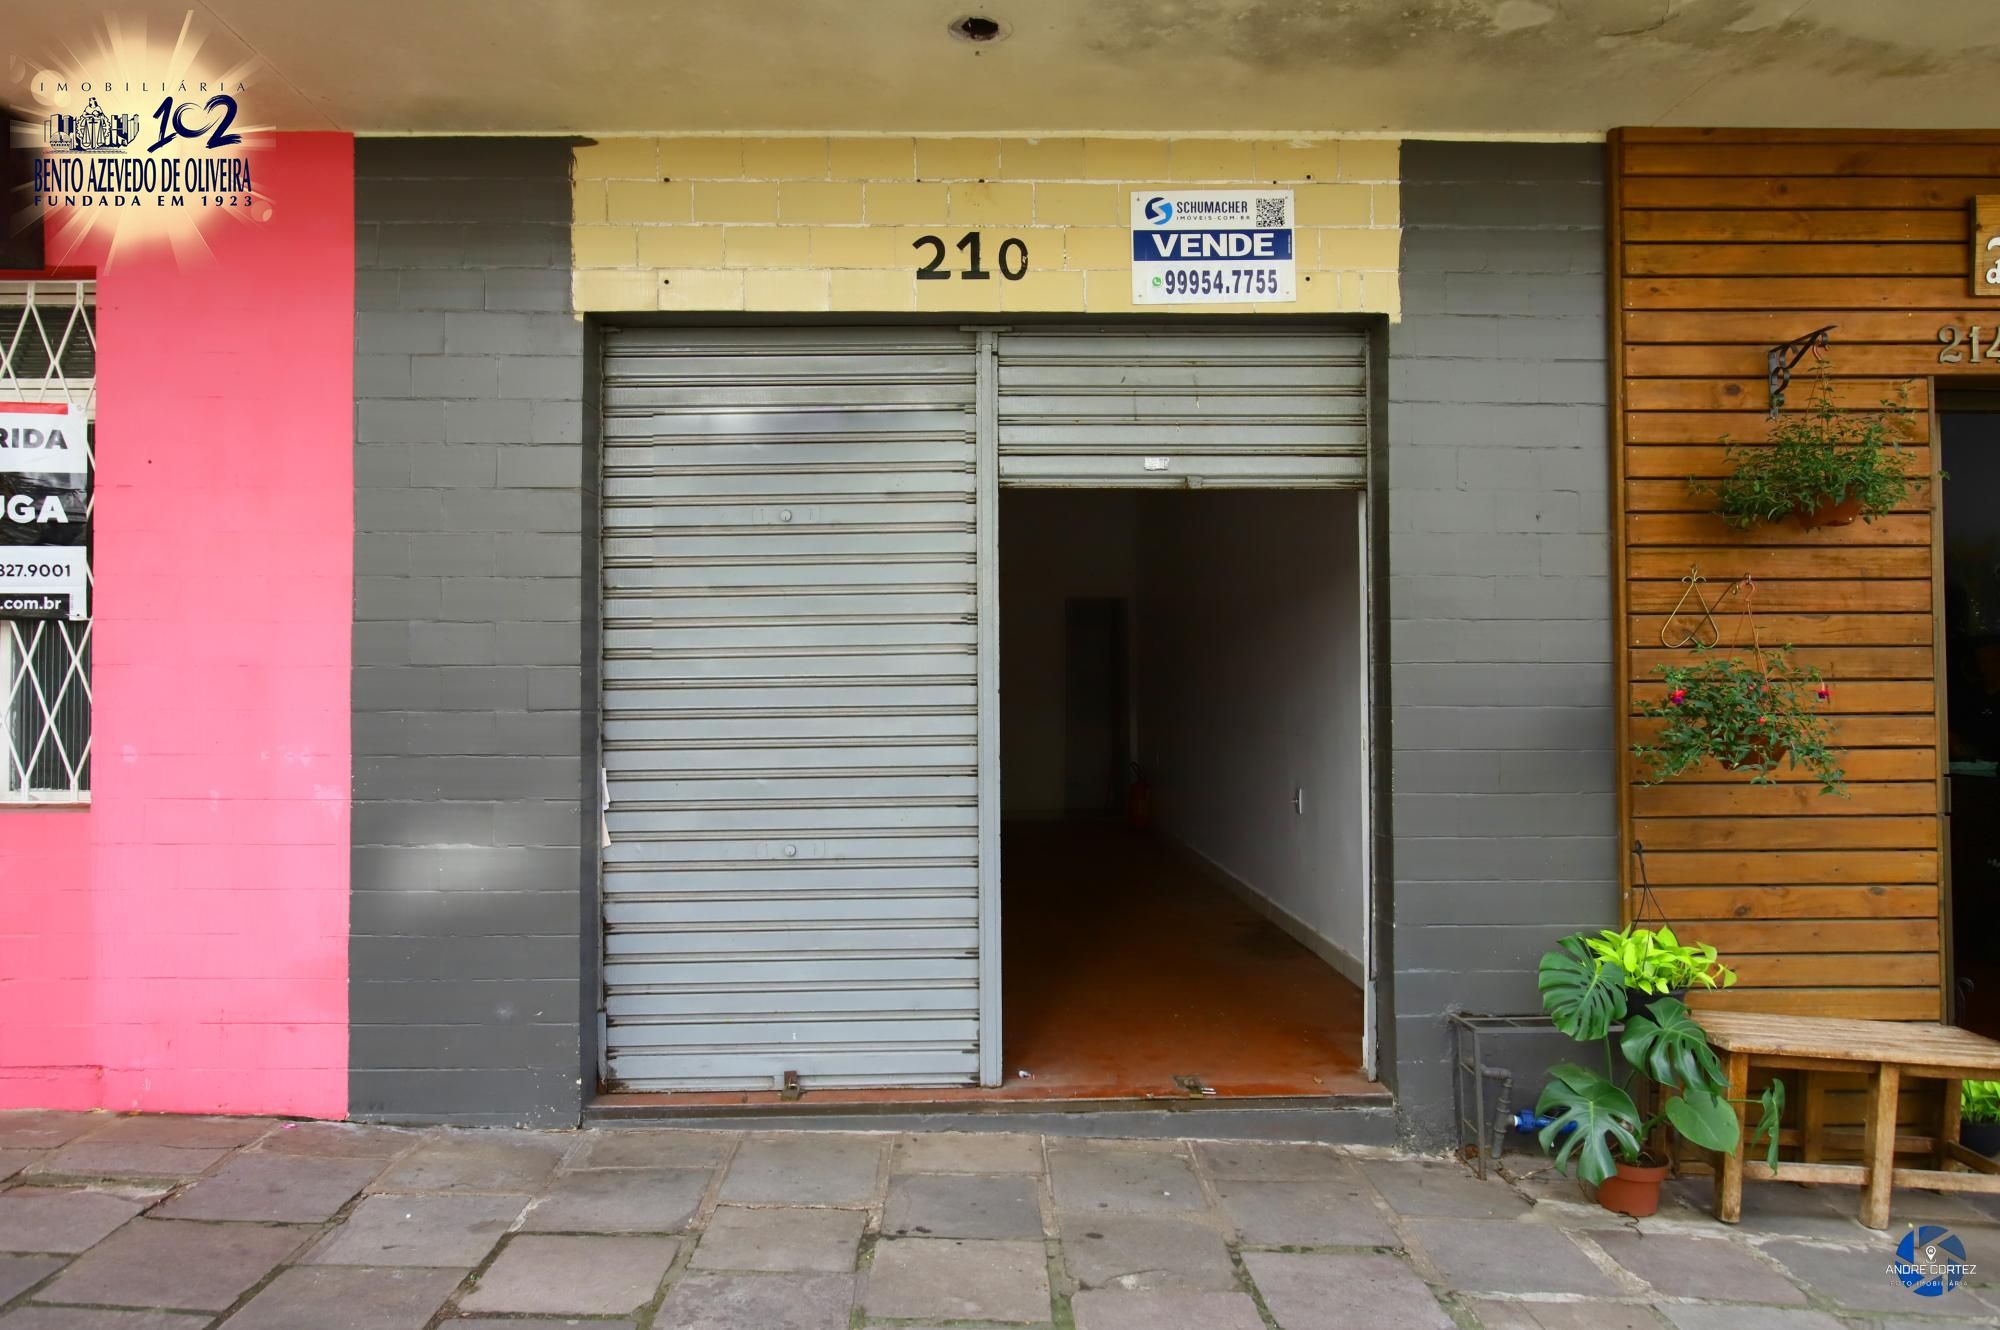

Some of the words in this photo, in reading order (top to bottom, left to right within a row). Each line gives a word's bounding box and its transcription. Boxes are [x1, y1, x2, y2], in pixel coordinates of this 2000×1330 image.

[1176, 201, 1248, 214] SCHUMACHER
[912, 231, 1029, 281] 210
[1151, 232, 1275, 258] VENDE
[1165, 269, 1278, 295] 99954.7755
[0, 495, 70, 524] GA
